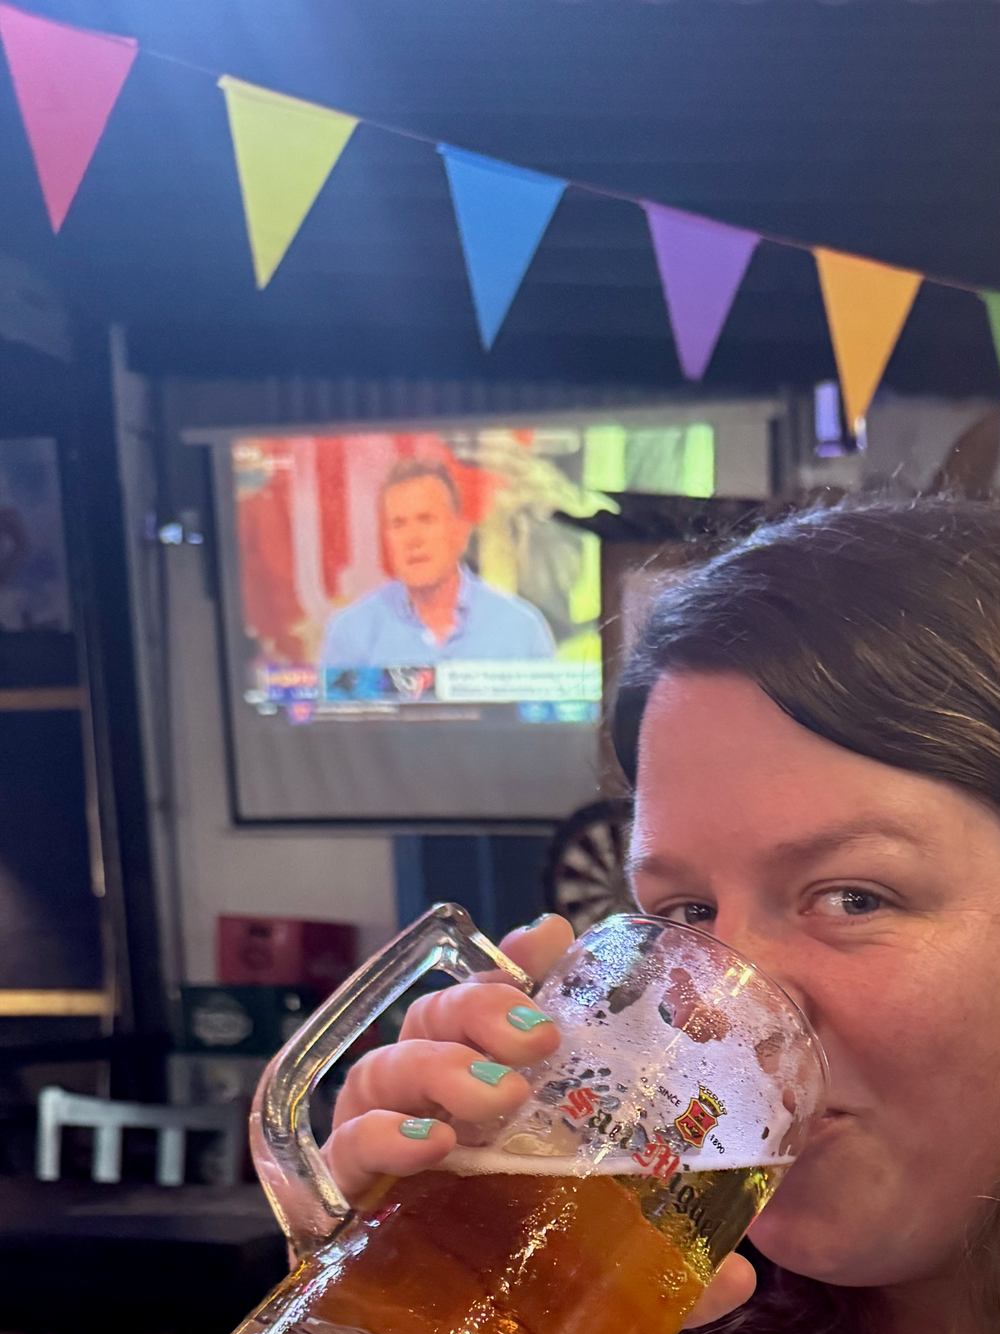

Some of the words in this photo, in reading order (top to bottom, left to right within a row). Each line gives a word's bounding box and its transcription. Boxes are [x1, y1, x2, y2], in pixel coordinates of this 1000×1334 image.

[559, 1087, 633, 1149] San
[657, 1085, 682, 1107] SINCE
[709, 1134, 726, 1155] 1890
